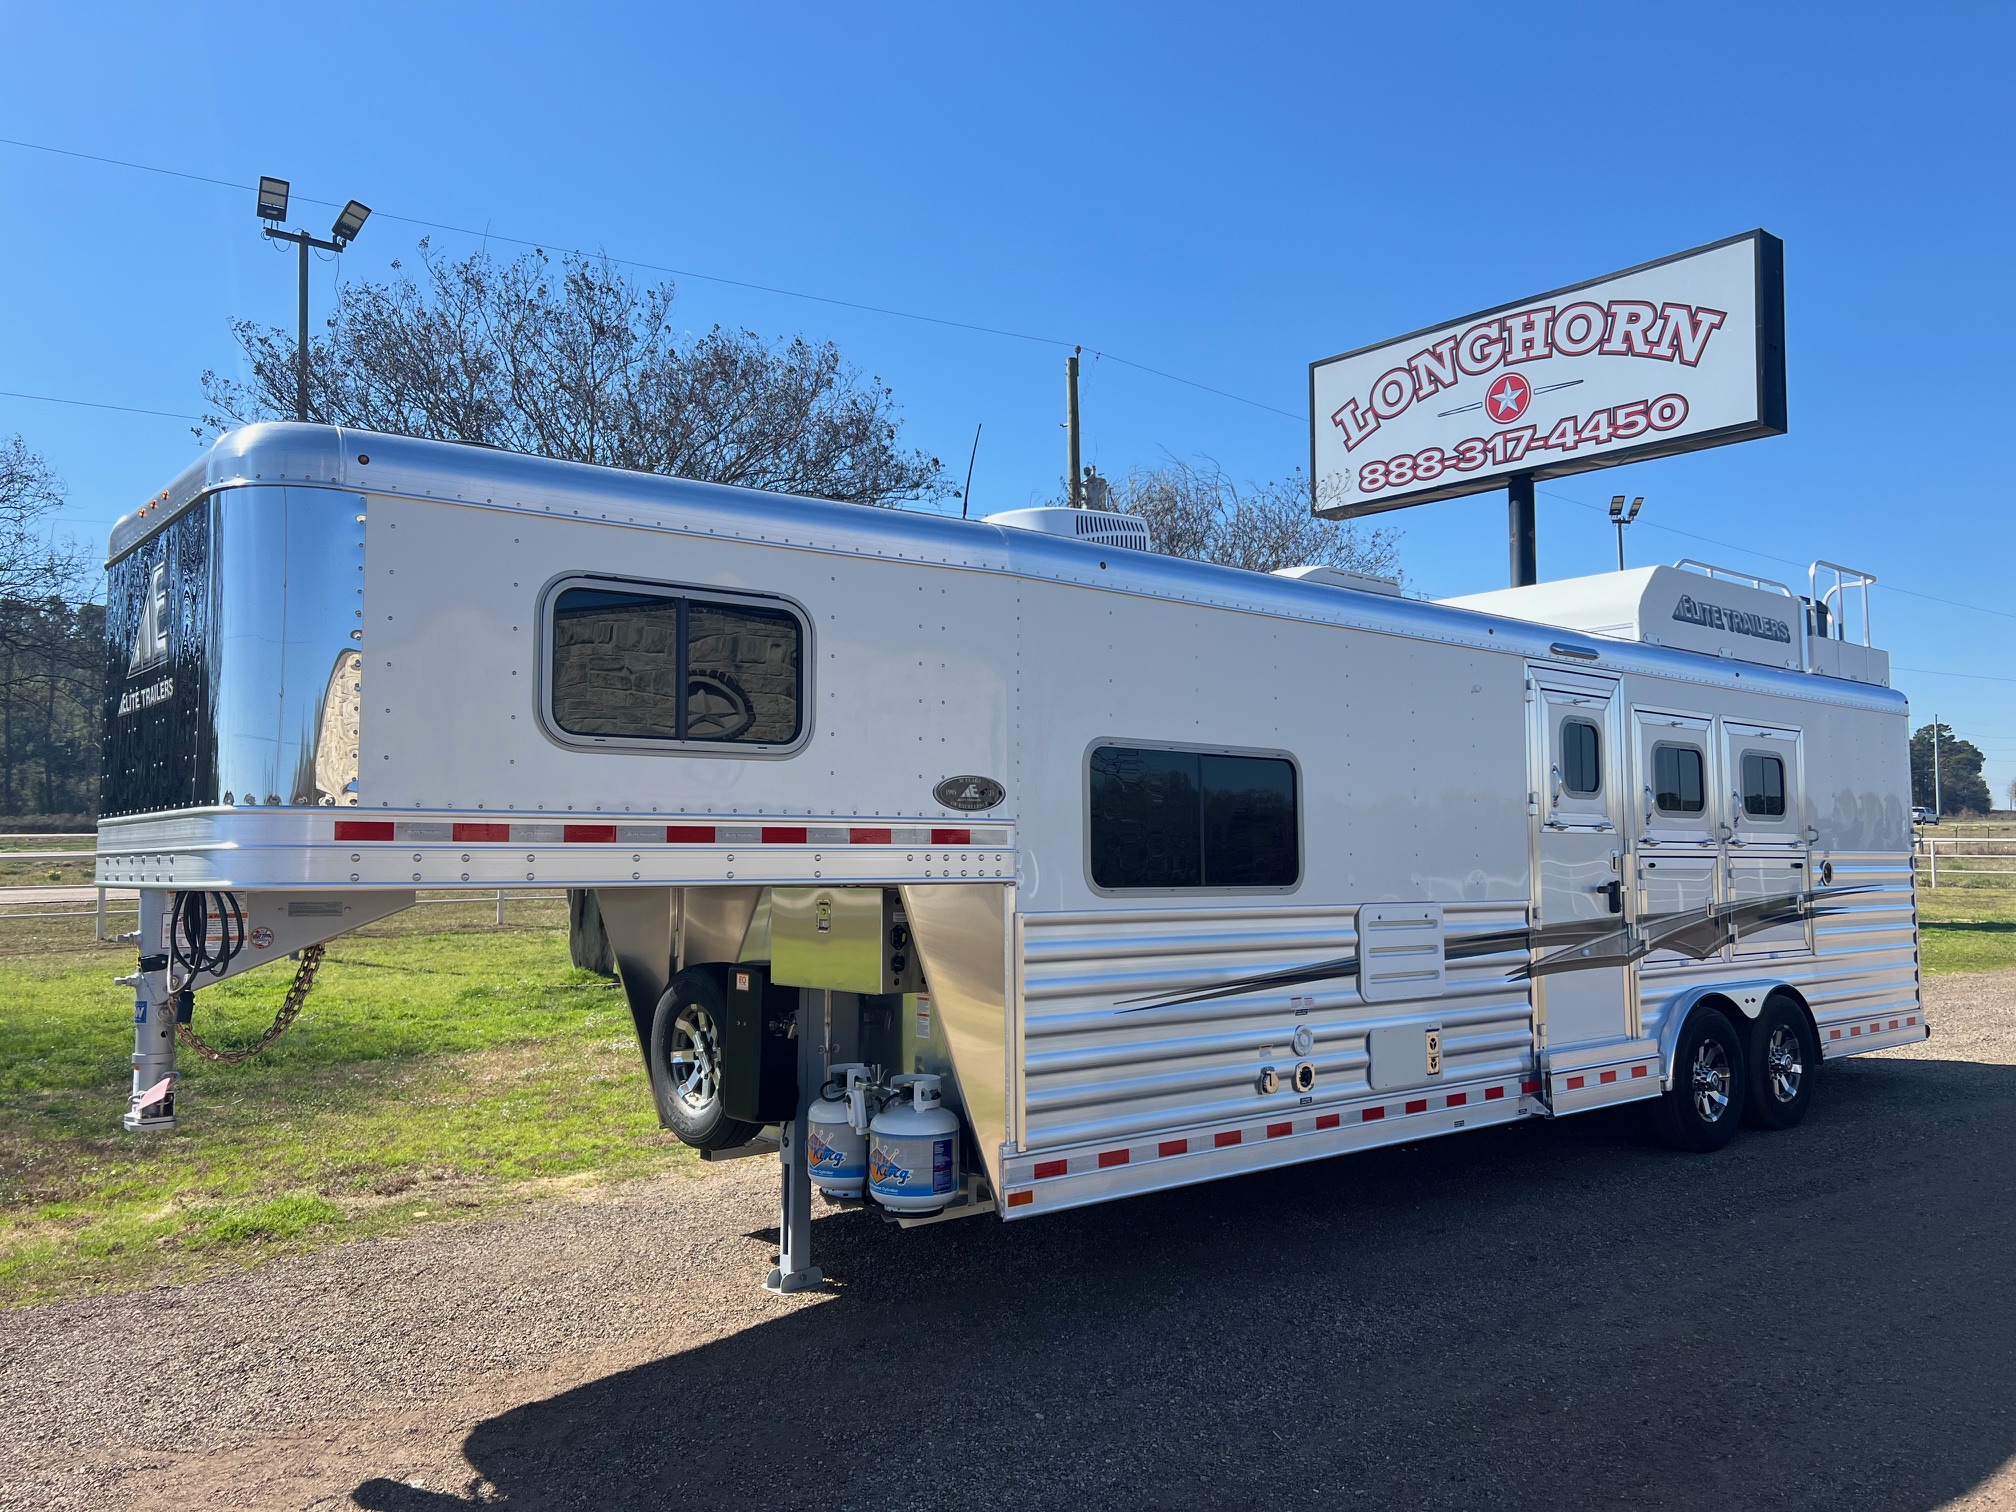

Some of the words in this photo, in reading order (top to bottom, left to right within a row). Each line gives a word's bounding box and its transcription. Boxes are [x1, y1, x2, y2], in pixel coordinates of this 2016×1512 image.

[1332, 300, 1728, 453] LONGHORN
[1359, 393, 1689, 493] 888-317-4450
[1672, 594, 1725, 630] ELITE
[1722, 608, 1790, 643] TRAILERS
[117, 692, 141, 717] ELITE
[141, 678, 174, 709] TRAILERS
[959, 801, 988, 809] EXCELLENCE
[739, 976, 747, 987] EQ
